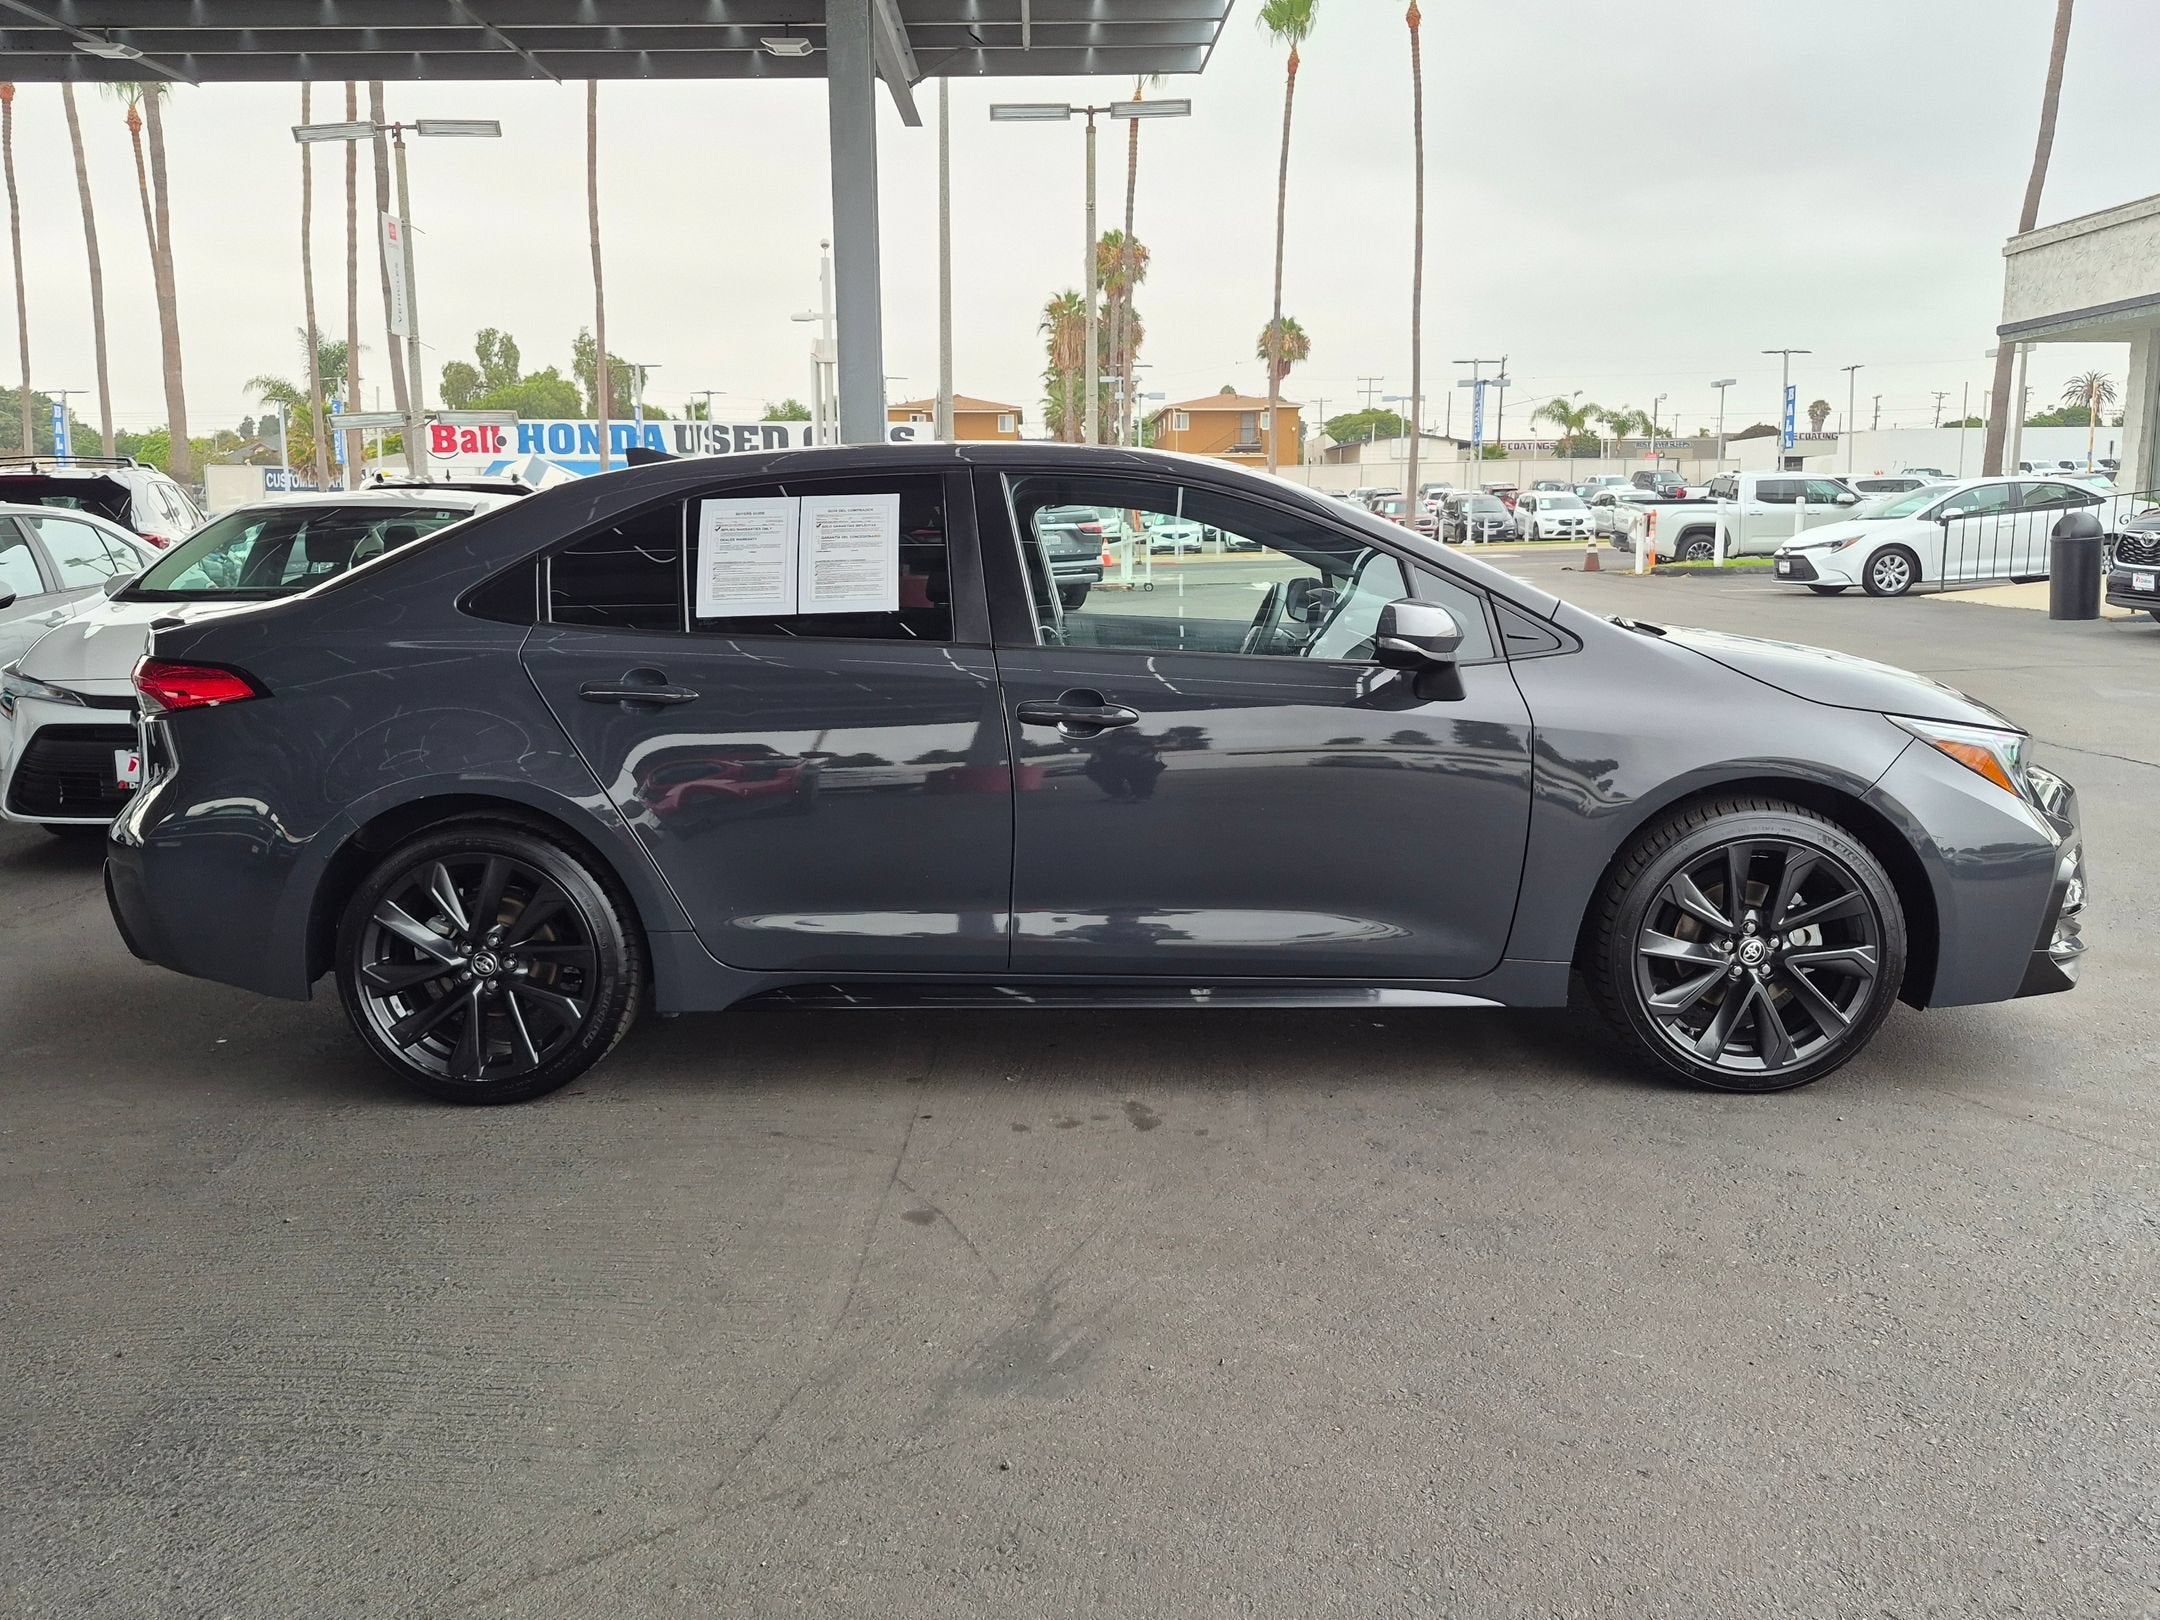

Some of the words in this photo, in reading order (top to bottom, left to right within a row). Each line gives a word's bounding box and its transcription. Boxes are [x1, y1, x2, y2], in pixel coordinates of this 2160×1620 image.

[430, 424, 502, 454] Ball
[517, 423, 668, 455] HONDA
[673, 424, 790, 455] USED
[1785, 387, 1795, 449] BALL
